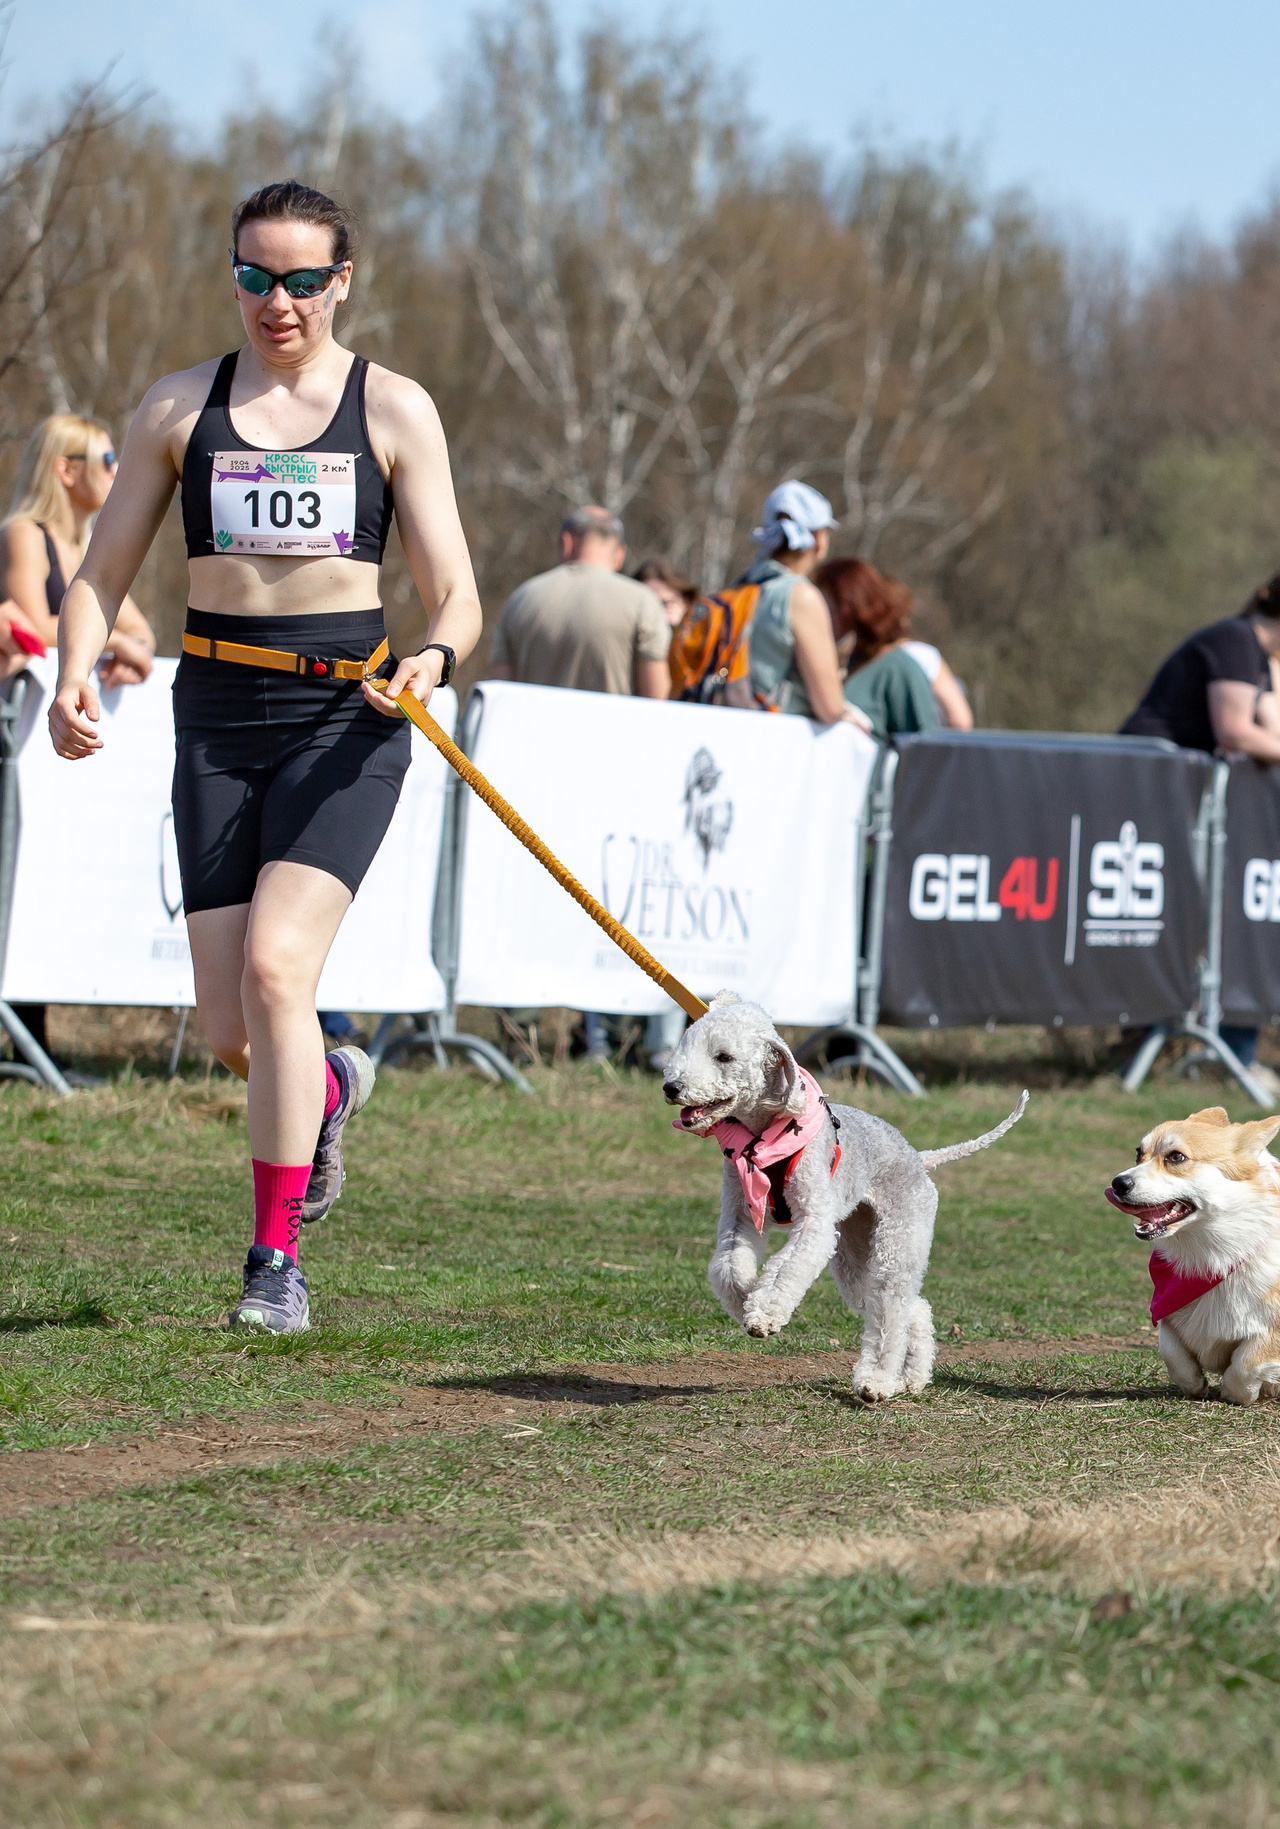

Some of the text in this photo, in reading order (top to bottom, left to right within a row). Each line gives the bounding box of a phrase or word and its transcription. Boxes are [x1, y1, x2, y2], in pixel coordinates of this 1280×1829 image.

[322, 464, 328, 472] 2
[244, 489, 322, 529] 103
[909, 853, 1060, 922] GEL4U
